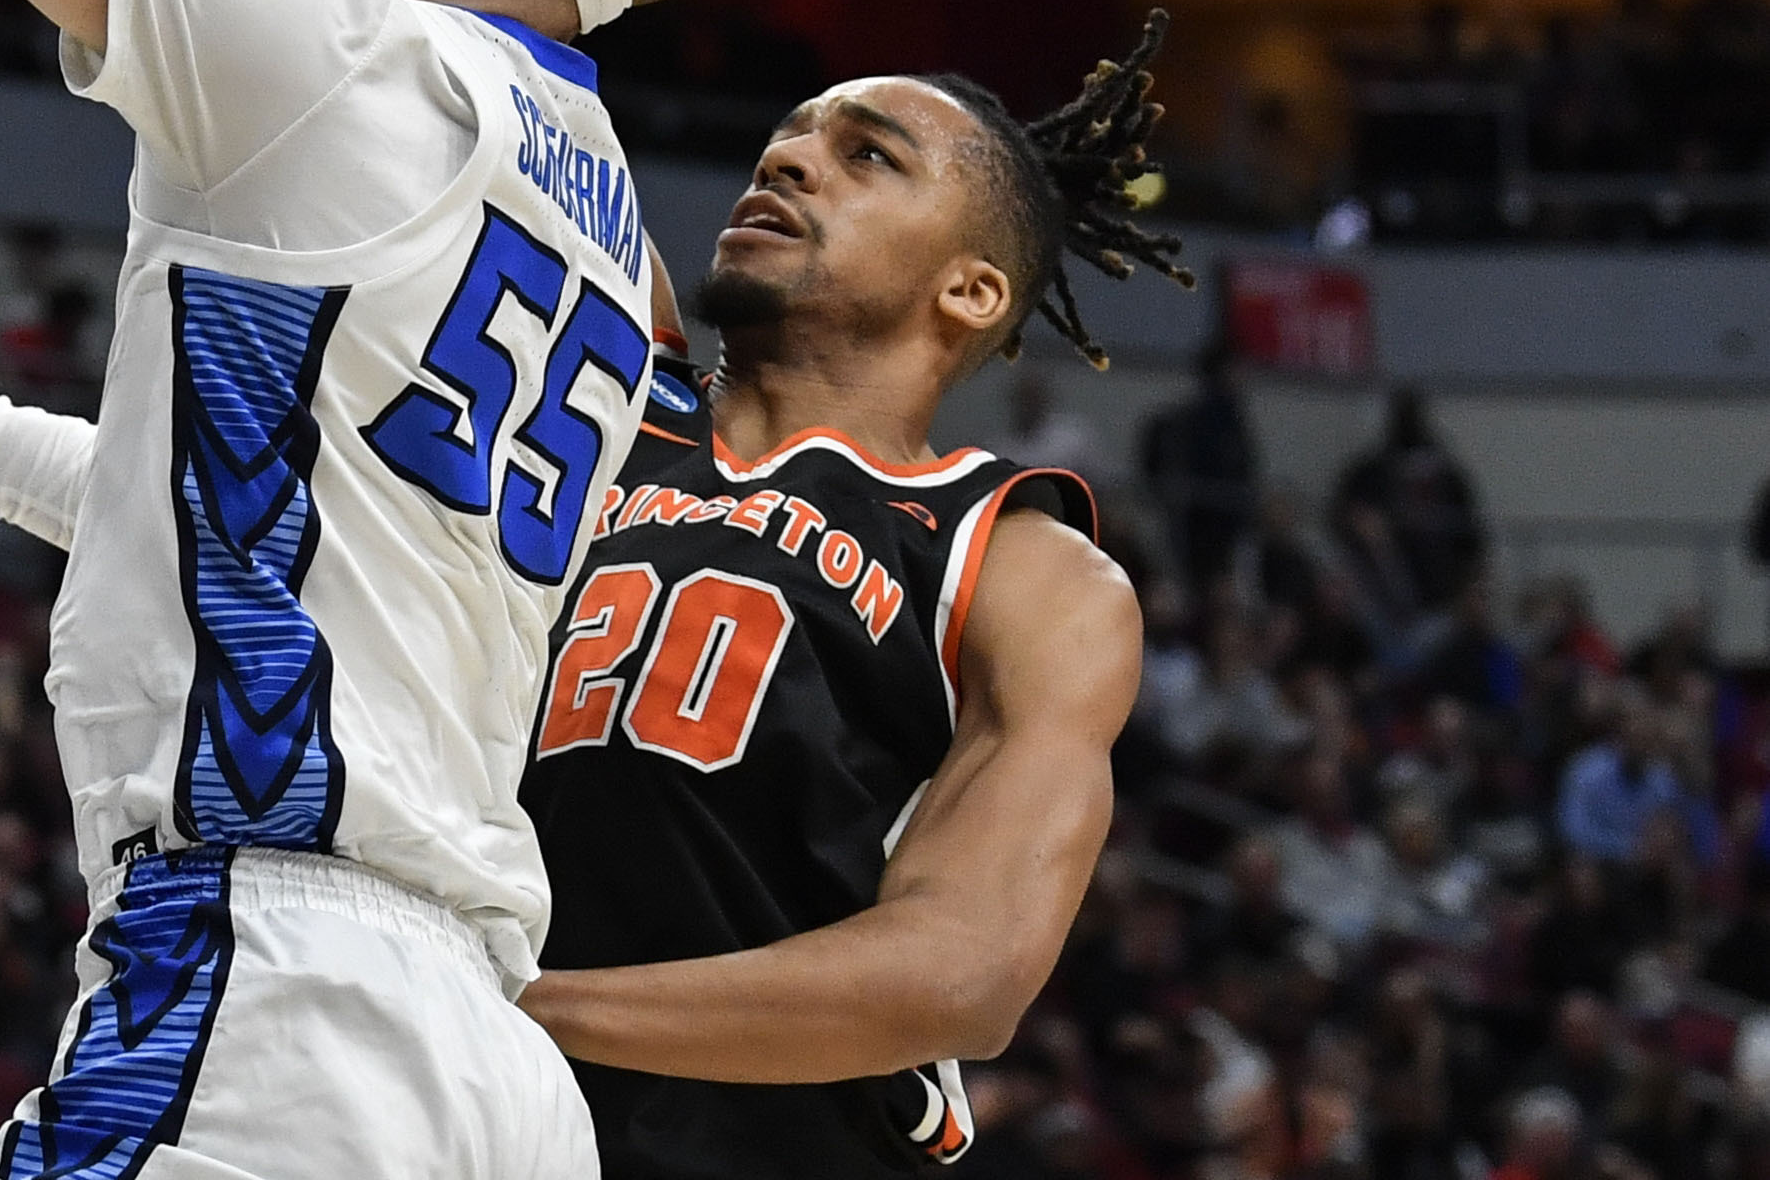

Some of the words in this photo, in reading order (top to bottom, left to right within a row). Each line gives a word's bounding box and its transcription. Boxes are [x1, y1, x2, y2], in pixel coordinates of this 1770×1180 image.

[358, 199, 650, 587] 55
[591, 483, 904, 646] RINCETON
[536, 562, 795, 774] 20
[120, 841, 147, 864] 46
